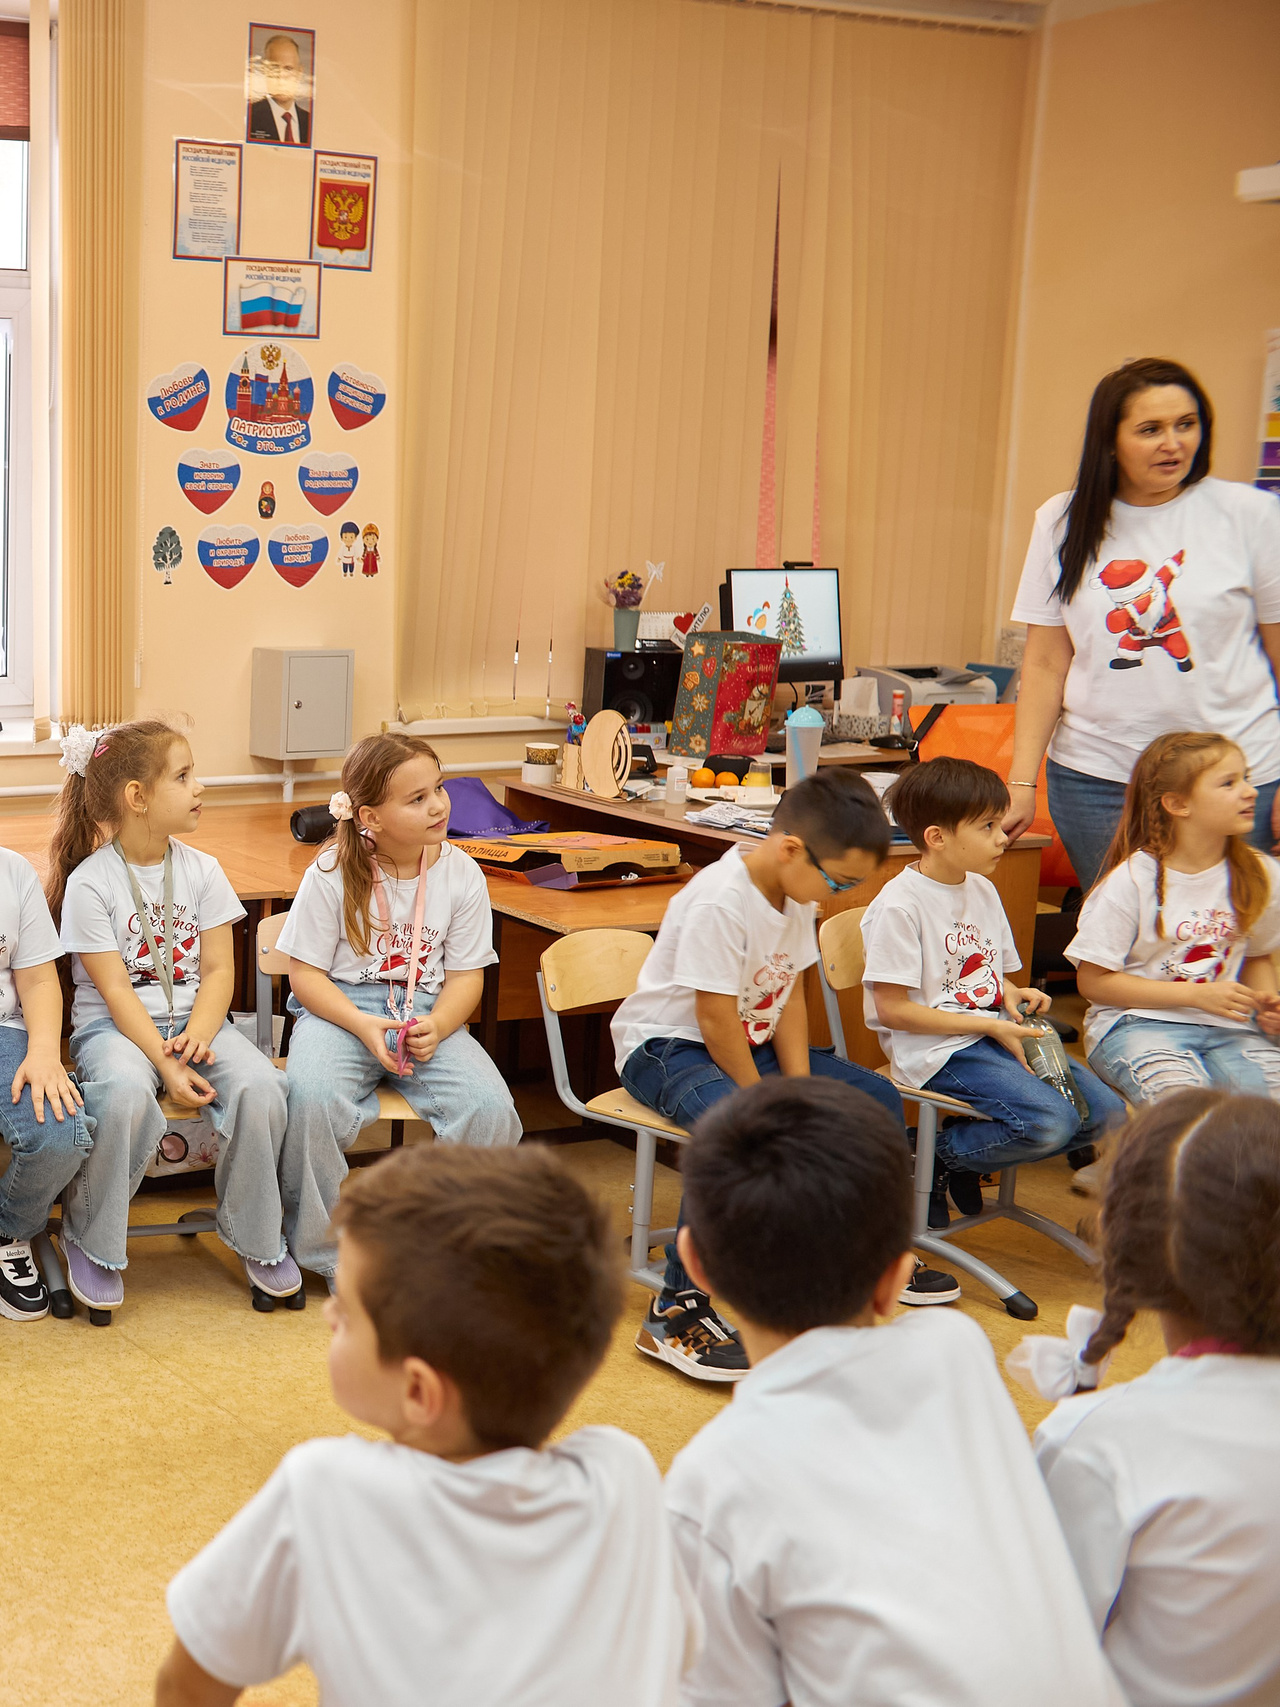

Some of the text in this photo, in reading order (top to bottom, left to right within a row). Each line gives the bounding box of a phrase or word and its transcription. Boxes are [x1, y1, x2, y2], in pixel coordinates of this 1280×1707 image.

[160, 376, 194, 399] Любовь
[157, 381, 206, 415] к РОДИНЕ!
[200, 460, 220, 469] Знать
[194, 472, 225, 480] историю
[309, 469, 328, 477] Знать
[185, 481, 206, 490] своей
[216, 538, 242, 546] Любить
[285, 534, 310, 542] Любовь
[288, 544, 312, 552] своему
